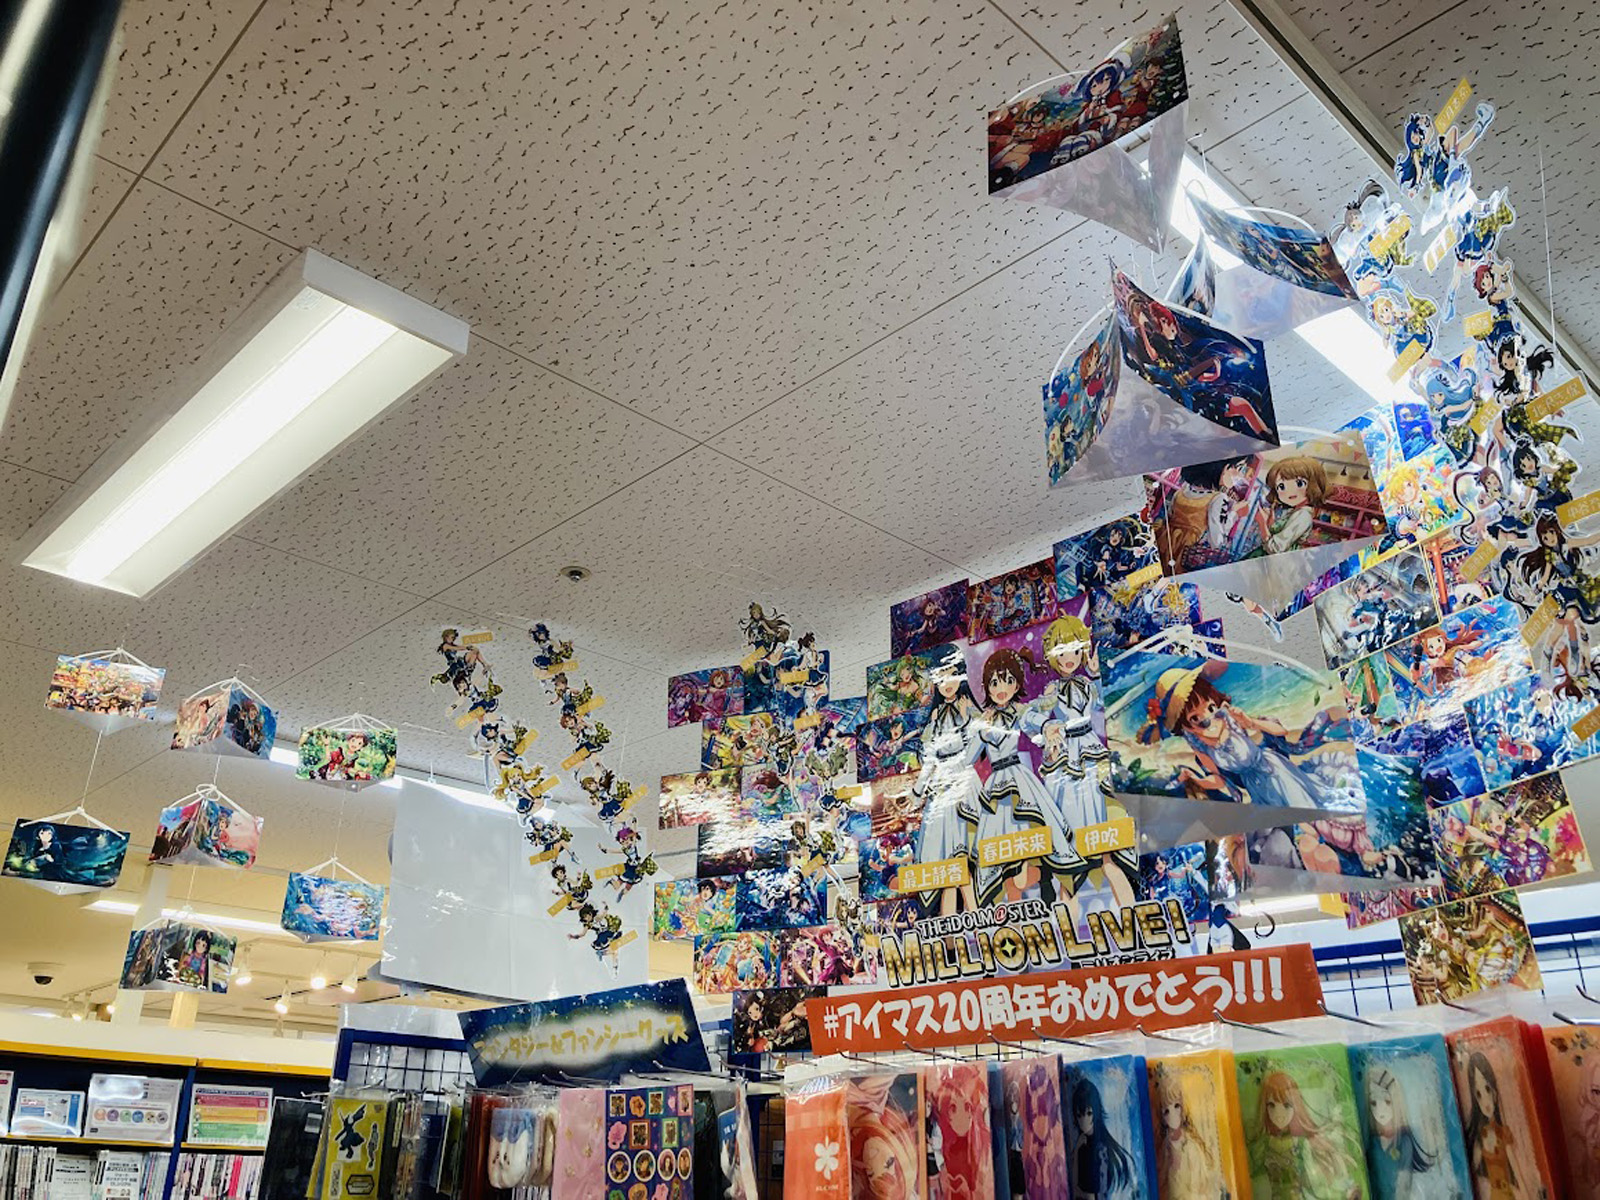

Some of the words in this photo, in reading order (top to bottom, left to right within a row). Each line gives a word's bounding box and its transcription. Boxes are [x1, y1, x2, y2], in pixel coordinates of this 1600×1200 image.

[982, 832, 1047, 863] 春日未来
[1084, 826, 1119, 851] 伊吹
[902, 862, 964, 890] 最上静香
[1053, 899, 1190, 959] LIVE!
[823, 957, 1284, 1040] #アイマス20周年おめでとう!!!
